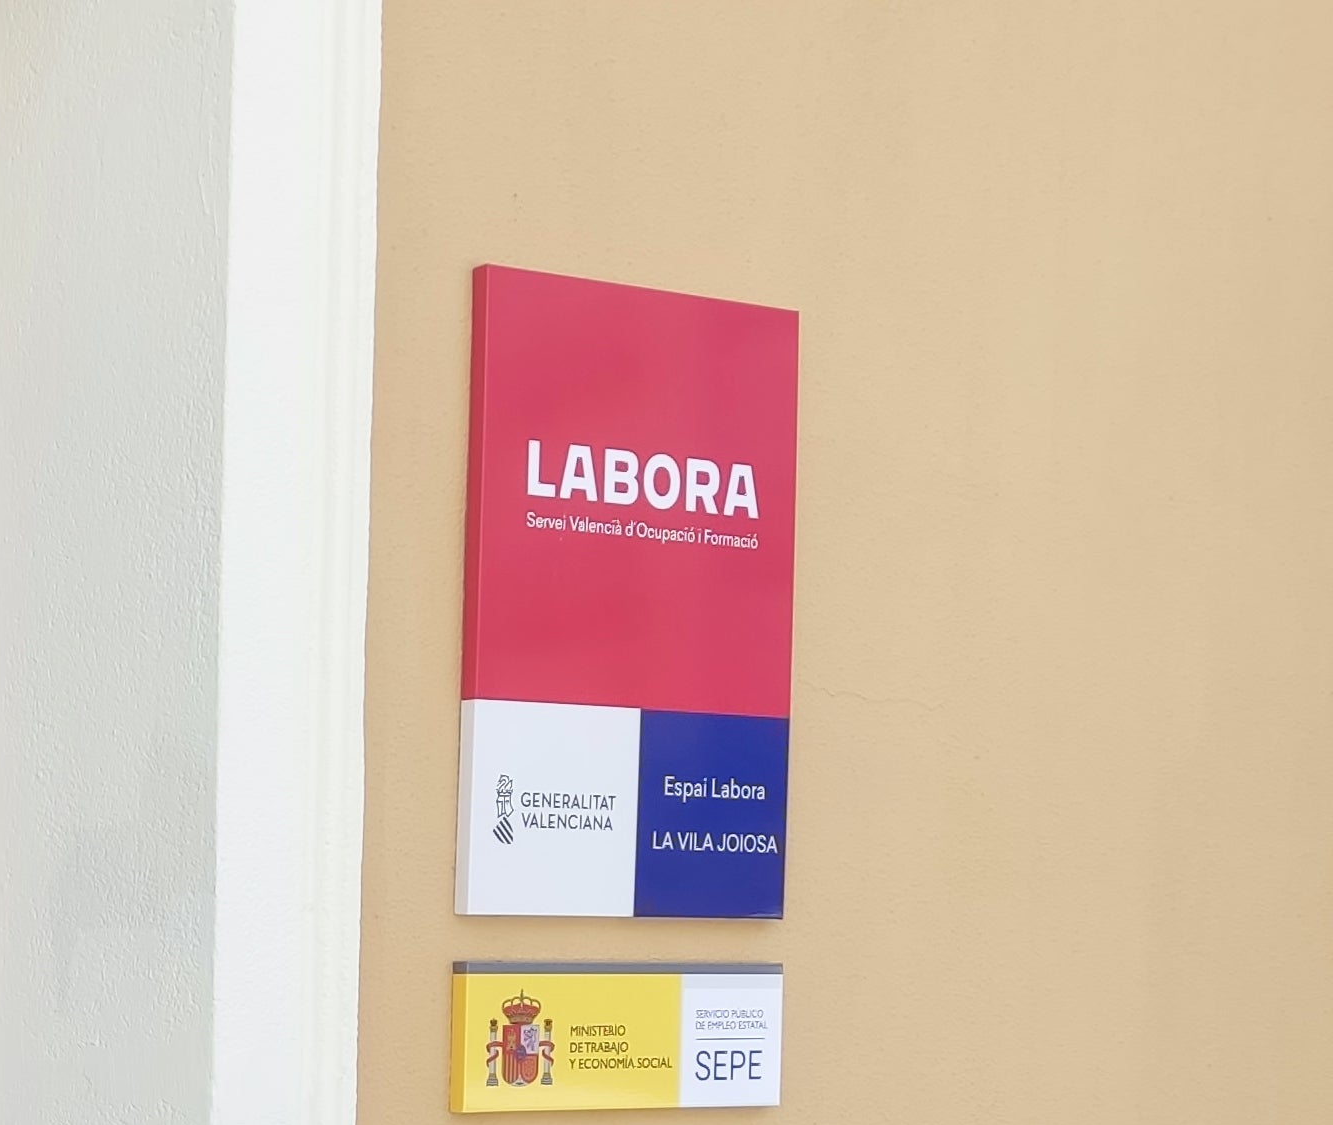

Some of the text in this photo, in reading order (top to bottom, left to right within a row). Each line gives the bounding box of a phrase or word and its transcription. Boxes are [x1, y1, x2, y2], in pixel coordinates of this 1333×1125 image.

[526, 439, 760, 520] LABORA
[526, 511, 567, 530] Servei
[569, 515, 623, 536] Valencià
[704, 529, 759, 550] Formació
[664, 775, 766, 803] Espai Labora
[520, 791, 617, 811] GENERALITAT
[521, 811, 614, 831] VALENCIANA
[652, 830, 779, 854] LA VILA JOIOSA
[570, 1024, 626, 1037] MINISTERIO
[695, 1020, 706, 1030] DE
[738, 1020, 768, 1030] ESTATAL
[569, 1041, 629, 1055] DE TRABAJO
[569, 1055, 673, 1070] Y ECONOMÍA SOCIAL
[695, 1050, 763, 1081] SEPE
